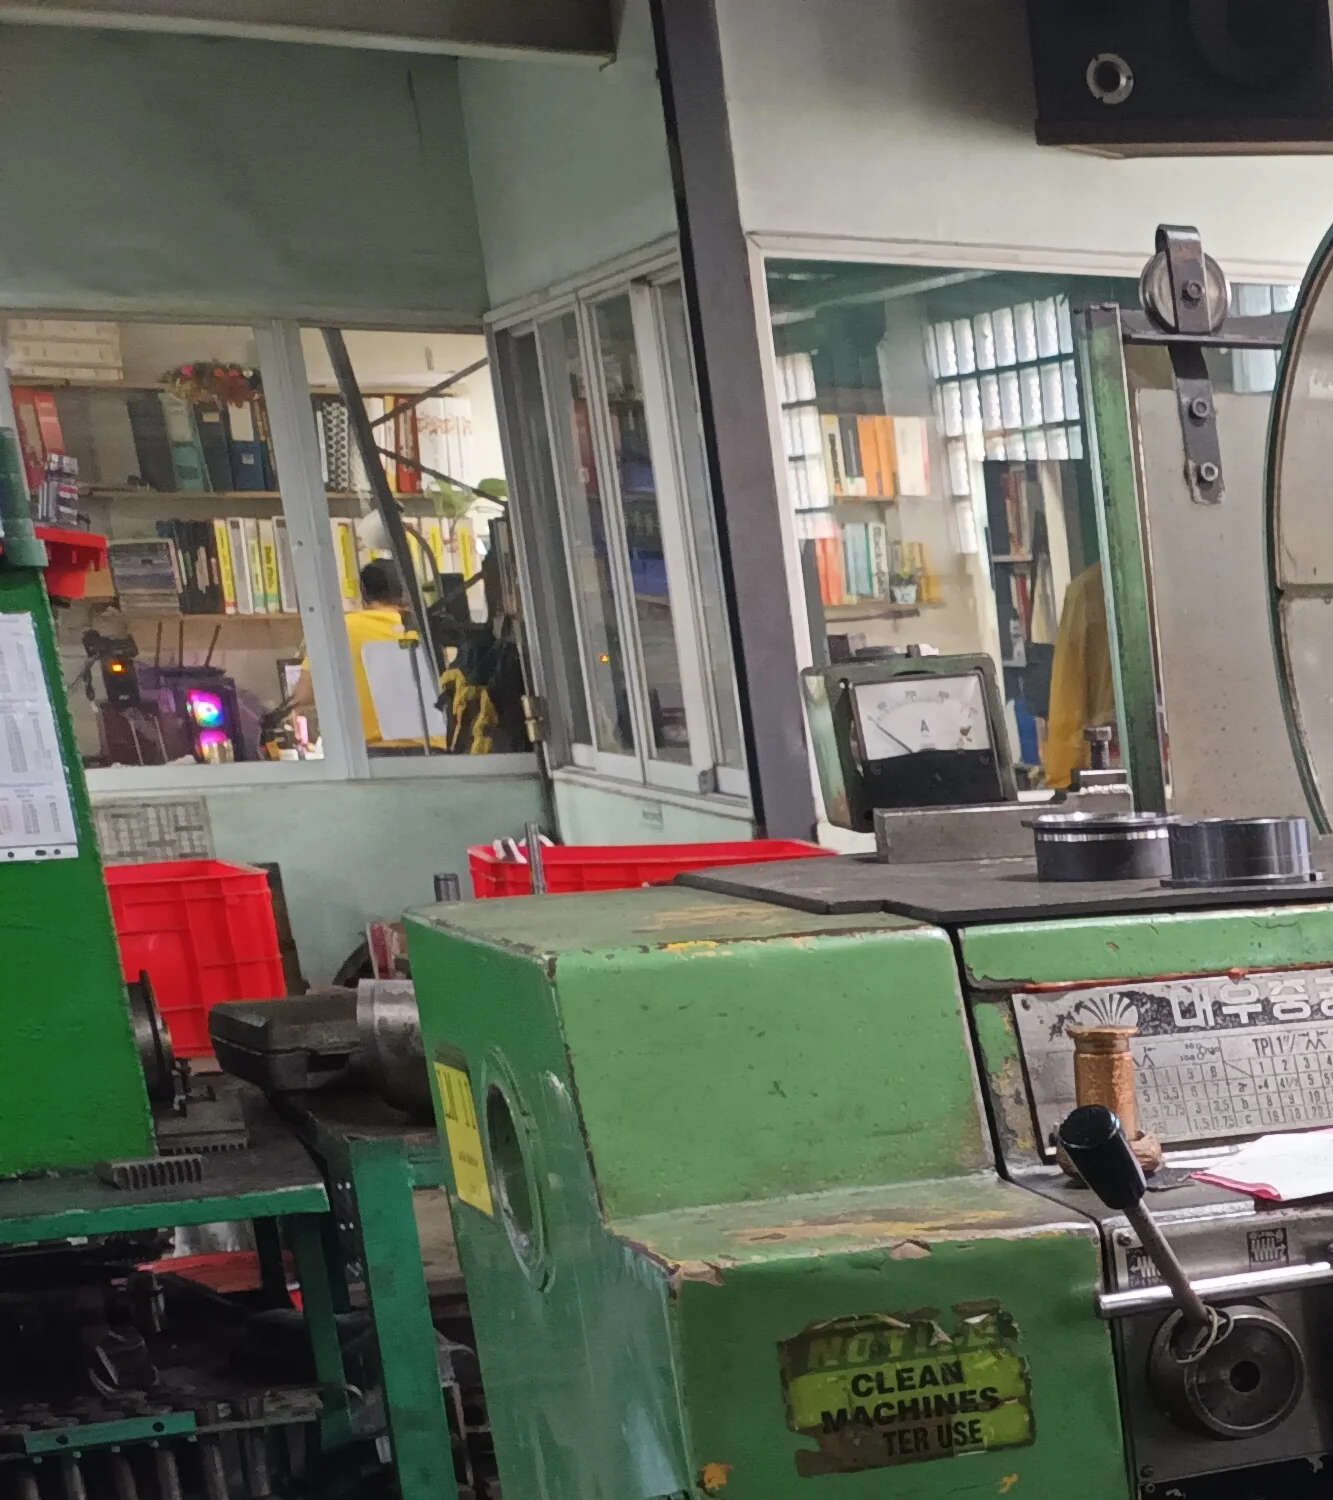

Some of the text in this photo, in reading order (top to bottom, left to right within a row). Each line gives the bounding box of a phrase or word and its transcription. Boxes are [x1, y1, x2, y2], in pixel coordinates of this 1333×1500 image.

[921, 719, 930, 733] A
[851, 1359, 965, 1398] CLEAN
[820, 1386, 1000, 1434] MACHINES
[937, 1418, 984, 1449] USE
